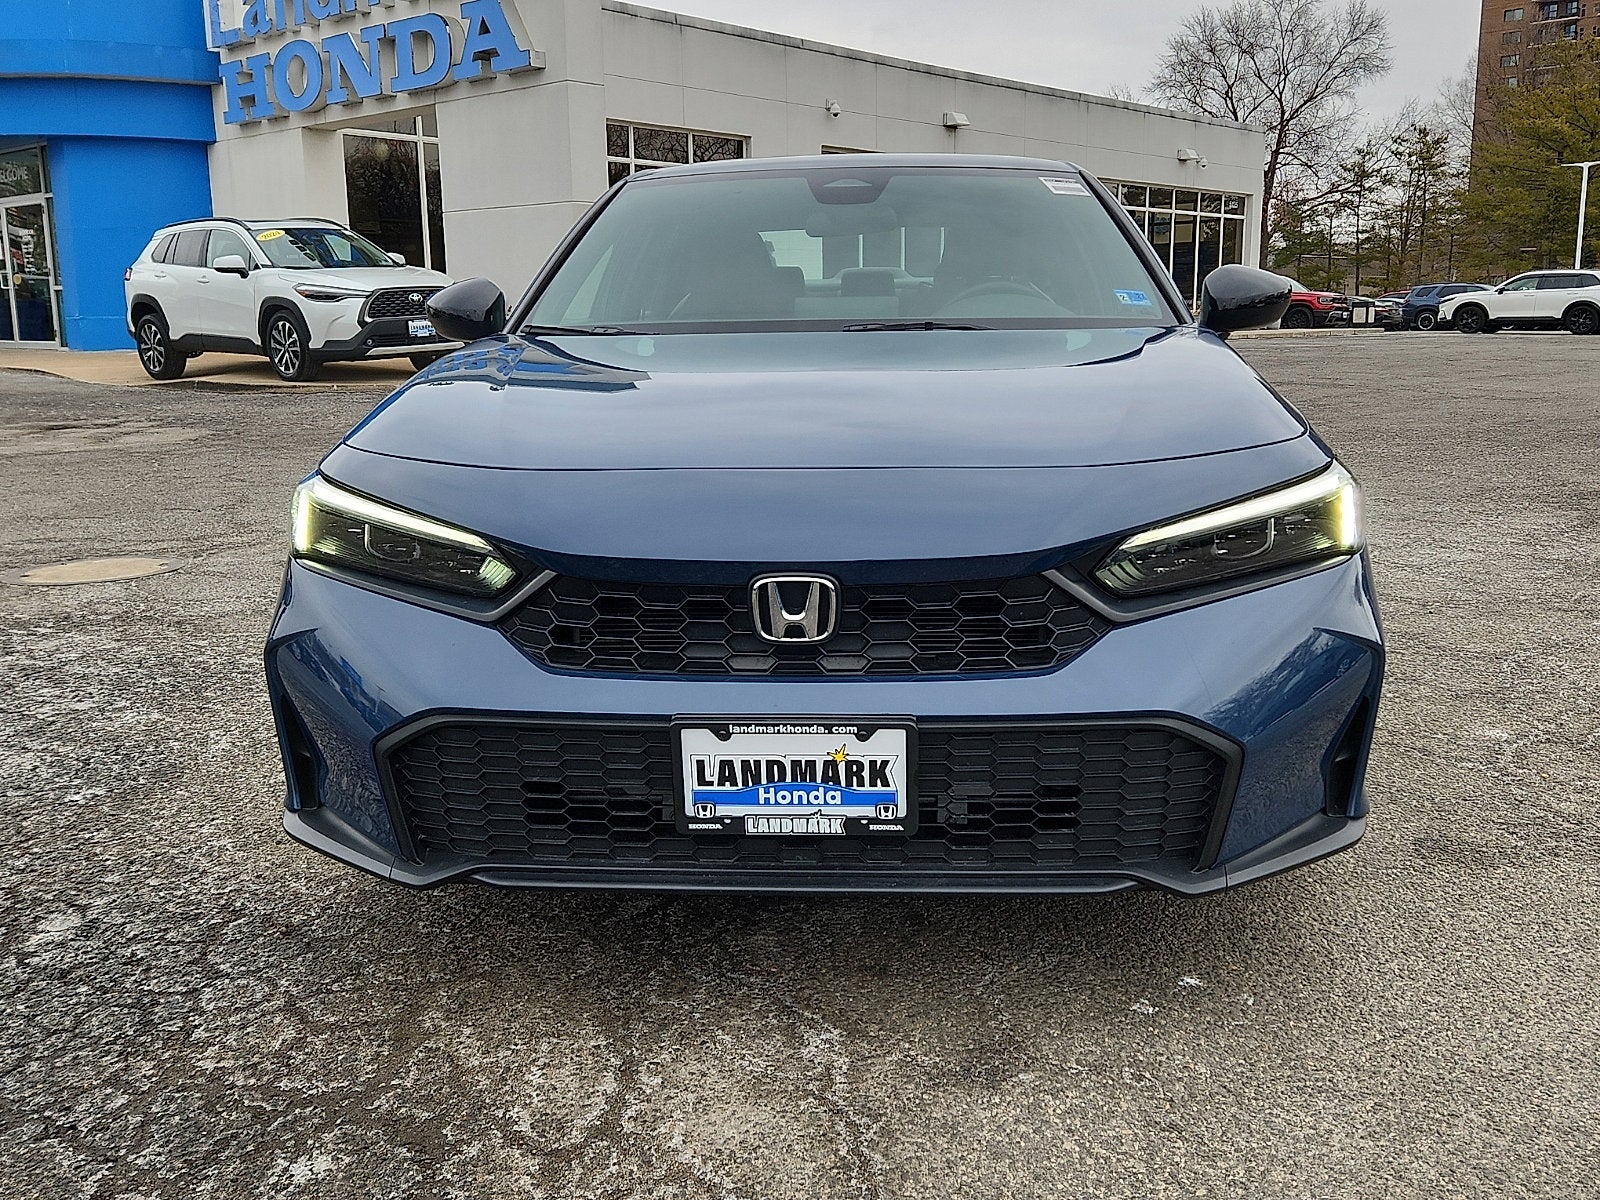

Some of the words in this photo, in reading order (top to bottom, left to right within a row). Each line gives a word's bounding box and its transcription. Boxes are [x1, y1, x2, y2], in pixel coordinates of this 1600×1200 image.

[219, 0, 530, 124] HONDA
[695, 758, 892, 788] LANDMARK
[759, 787, 842, 804] Honda
[747, 817, 843, 834] LANDMARK
